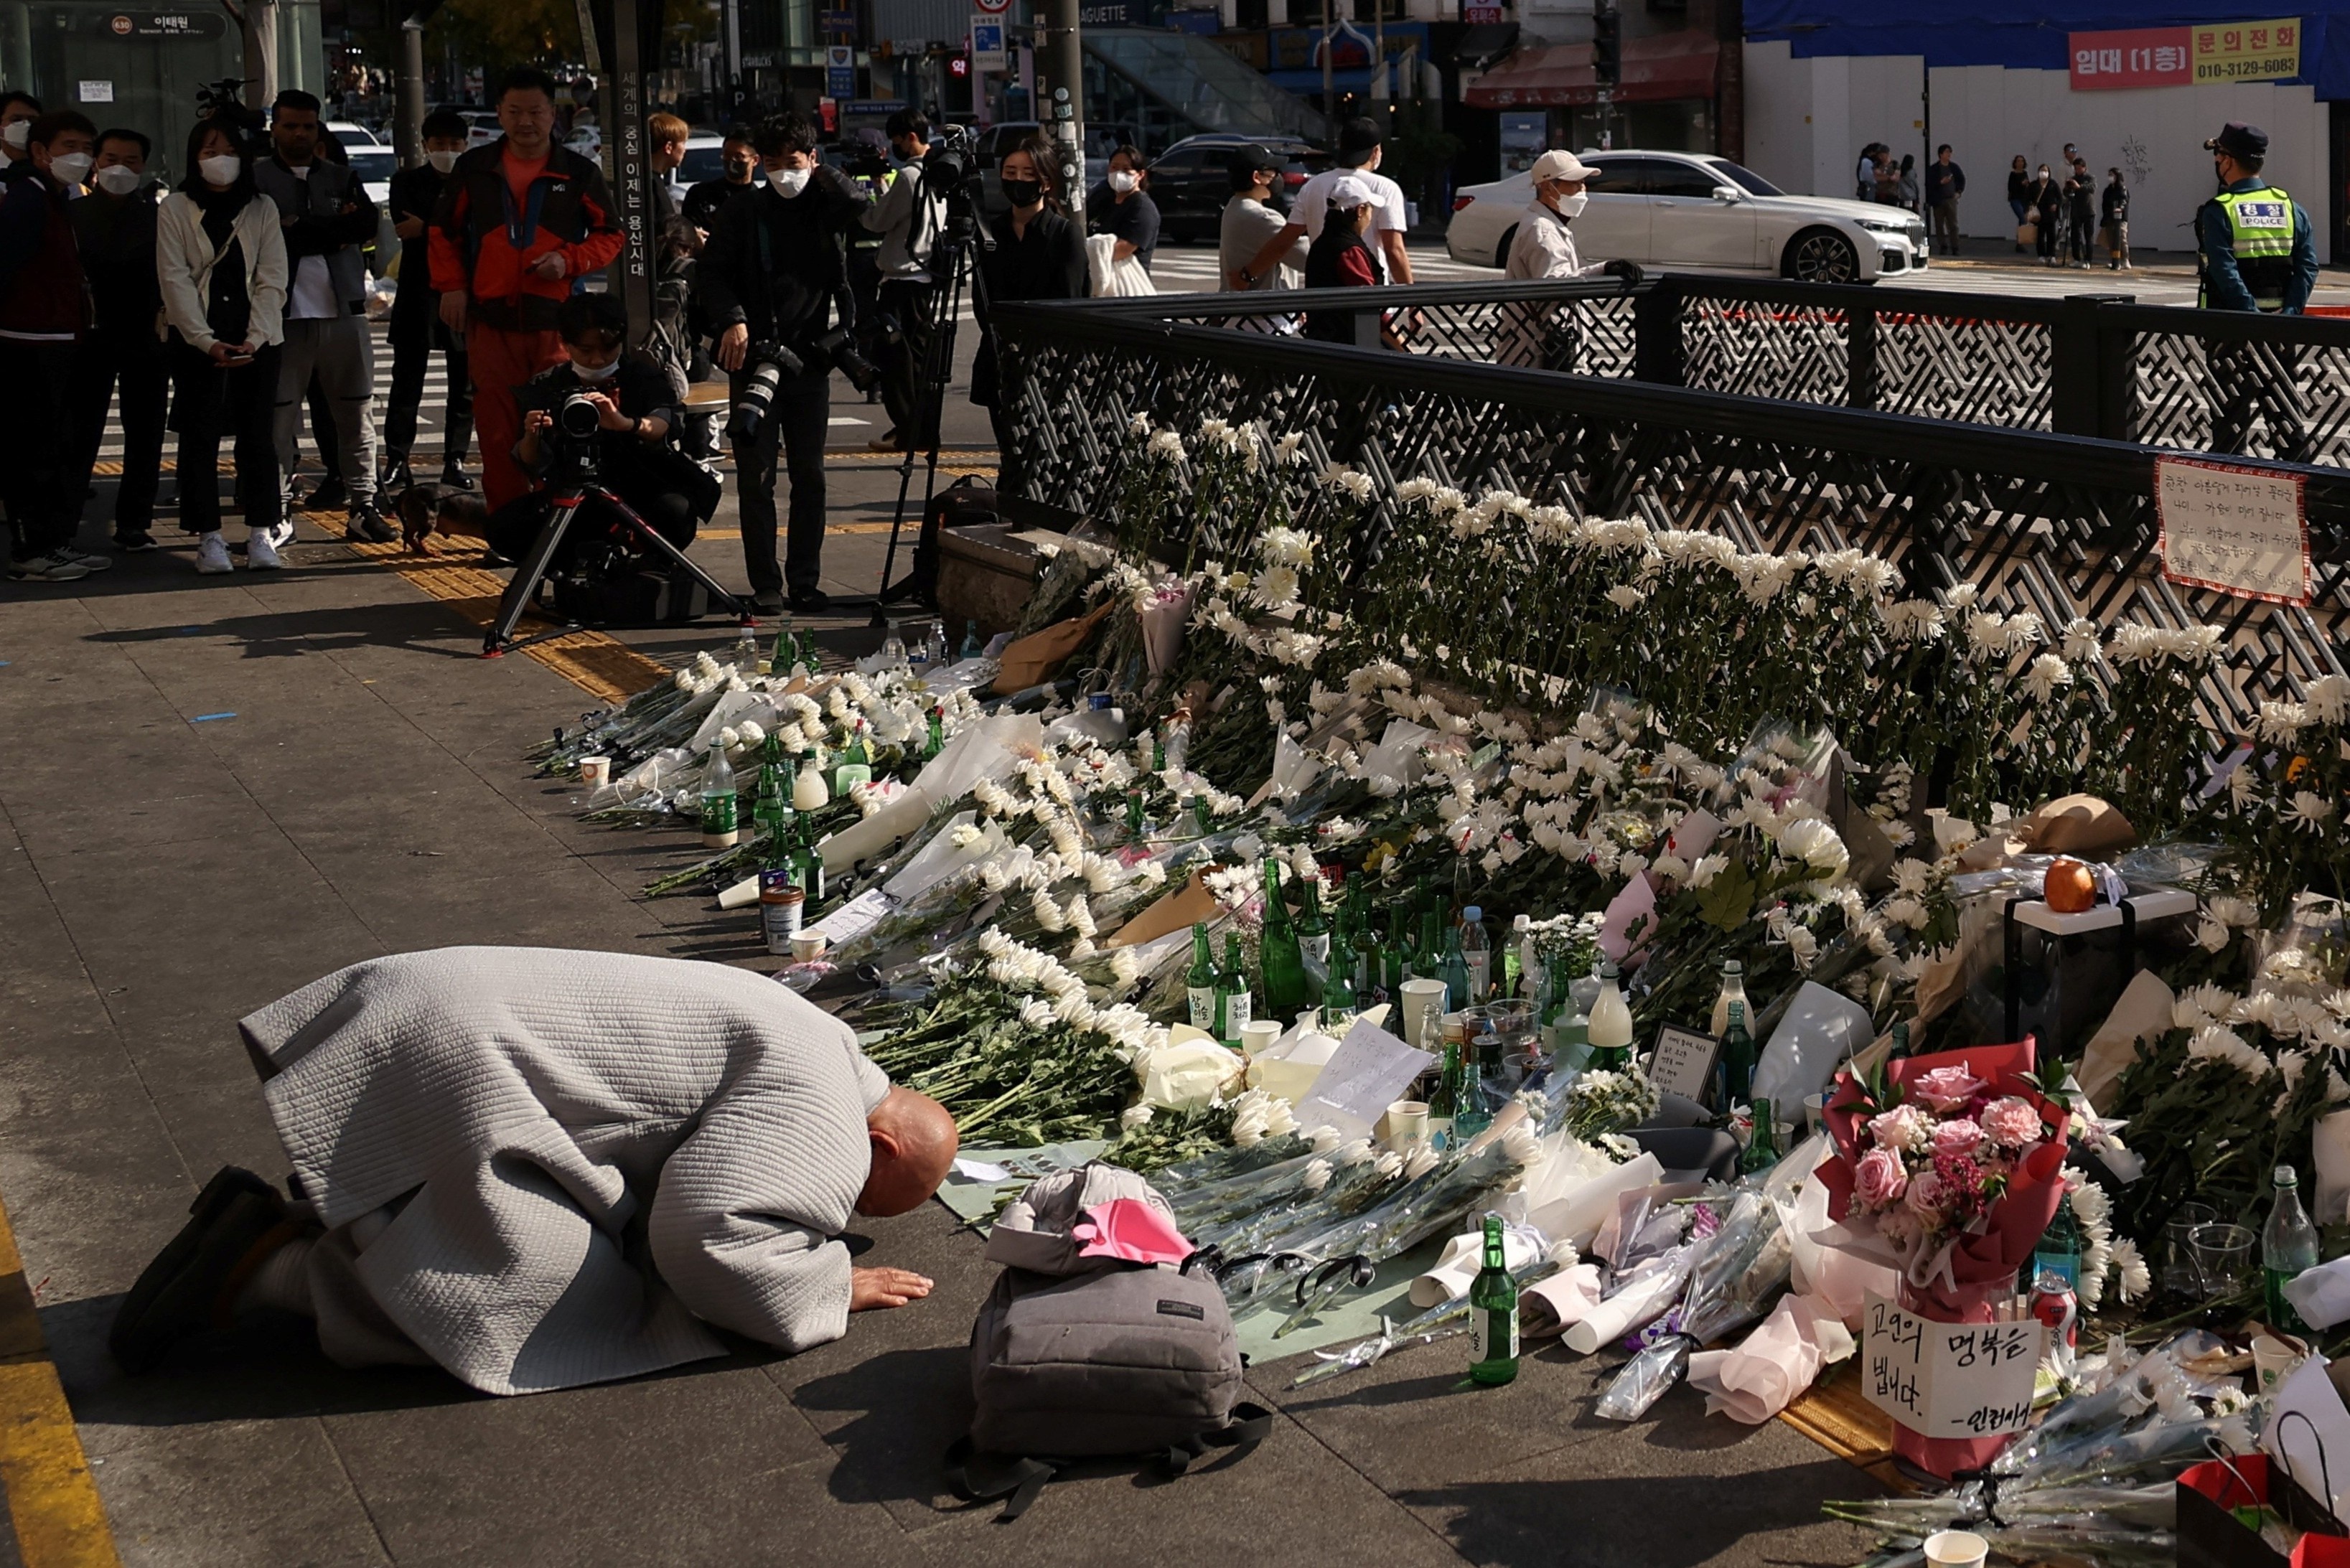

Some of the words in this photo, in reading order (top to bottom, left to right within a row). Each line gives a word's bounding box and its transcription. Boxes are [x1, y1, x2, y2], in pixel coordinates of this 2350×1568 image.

[154, 16, 188, 29] 이태원
[1080, 5, 1126, 23] AGUETTE
[952, 60, 965, 75] 약
[2076, 49, 2122, 75] 임대
[2198, 57, 2295, 78] 010-3129-6083
[623, 72, 638, 116] 세계의
[735, 92, 744, 106] P
[624, 125, 639, 155] 중심
[626, 163, 641, 208] 이제는
[2243, 204, 2280, 216] 경찰
[628, 216, 644, 276] 용산시대
[2194, 479, 2229, 495] 아름답게
[2205, 502, 2232, 517] 가슴이
[2206, 526, 2242, 541] 하늘에서
[1871, 1303, 1922, 1363] 고인의
[1949, 1328, 2028, 1366] 명복을
[1873, 1356, 1922, 1417] 빕니다.
